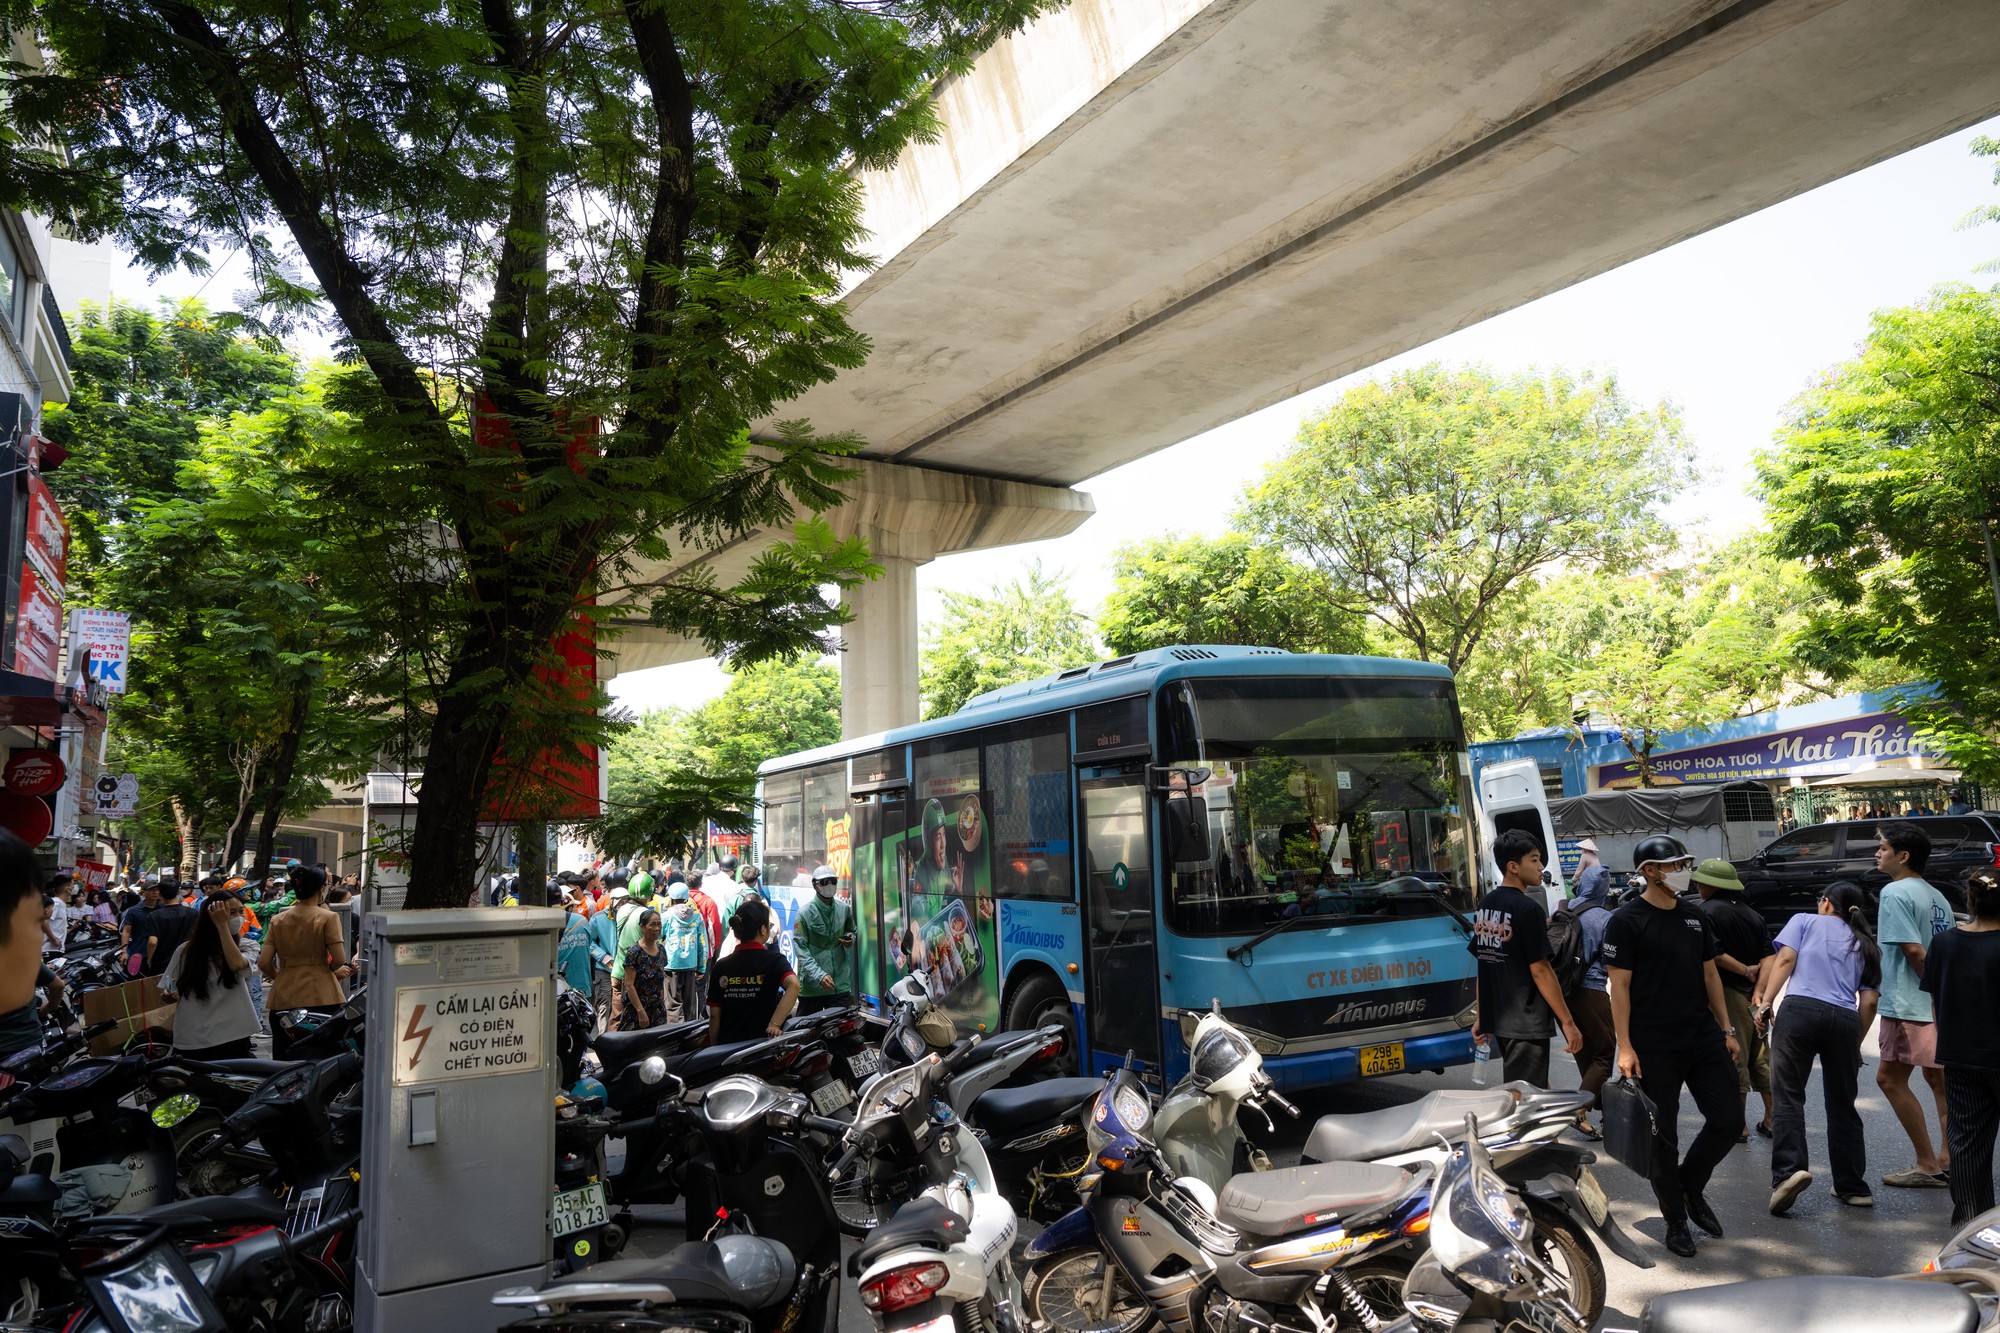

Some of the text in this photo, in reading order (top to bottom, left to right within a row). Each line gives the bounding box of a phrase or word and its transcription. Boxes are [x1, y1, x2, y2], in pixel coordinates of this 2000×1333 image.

[1767, 736, 1837, 764] Mai
[1656, 753, 1762, 772] SHOP HOA TƯƠI
[12, 768, 52, 782] Pizza
[19, 777, 46, 787] Hut
[578, 853, 596, 862] P25
[1003, 923, 1065, 950] HANOIBUS
[1307, 956, 1432, 989] CT XE ĐIỆN HÀ NỘI
[436, 993, 468, 1016] CẤM
[473, 996, 495, 1016] LẠI
[500, 988, 529, 1010] GẦN
[1323, 998, 1427, 1025] HANOIBUS
[459, 1017, 514, 1034] CÓ ĐIỆN
[449, 1031, 524, 1052] NGUY HIỂM
[444, 1049, 527, 1071] CHẾT NGƯỜI
[851, 1052, 873, 1067] 29-AC
[1373, 1045, 1392, 1060] 29B
[854, 1061, 879, 1077] 950.33
[1366, 1057, 1400, 1073] 404.55
[816, 1084, 842, 1102] 30-H1
[822, 1093, 848, 1112] 8901
[130, 1184, 158, 1198] HONDA
[554, 1205, 604, 1234] 018.23
[1123, 1216, 1141, 1225] TOY
